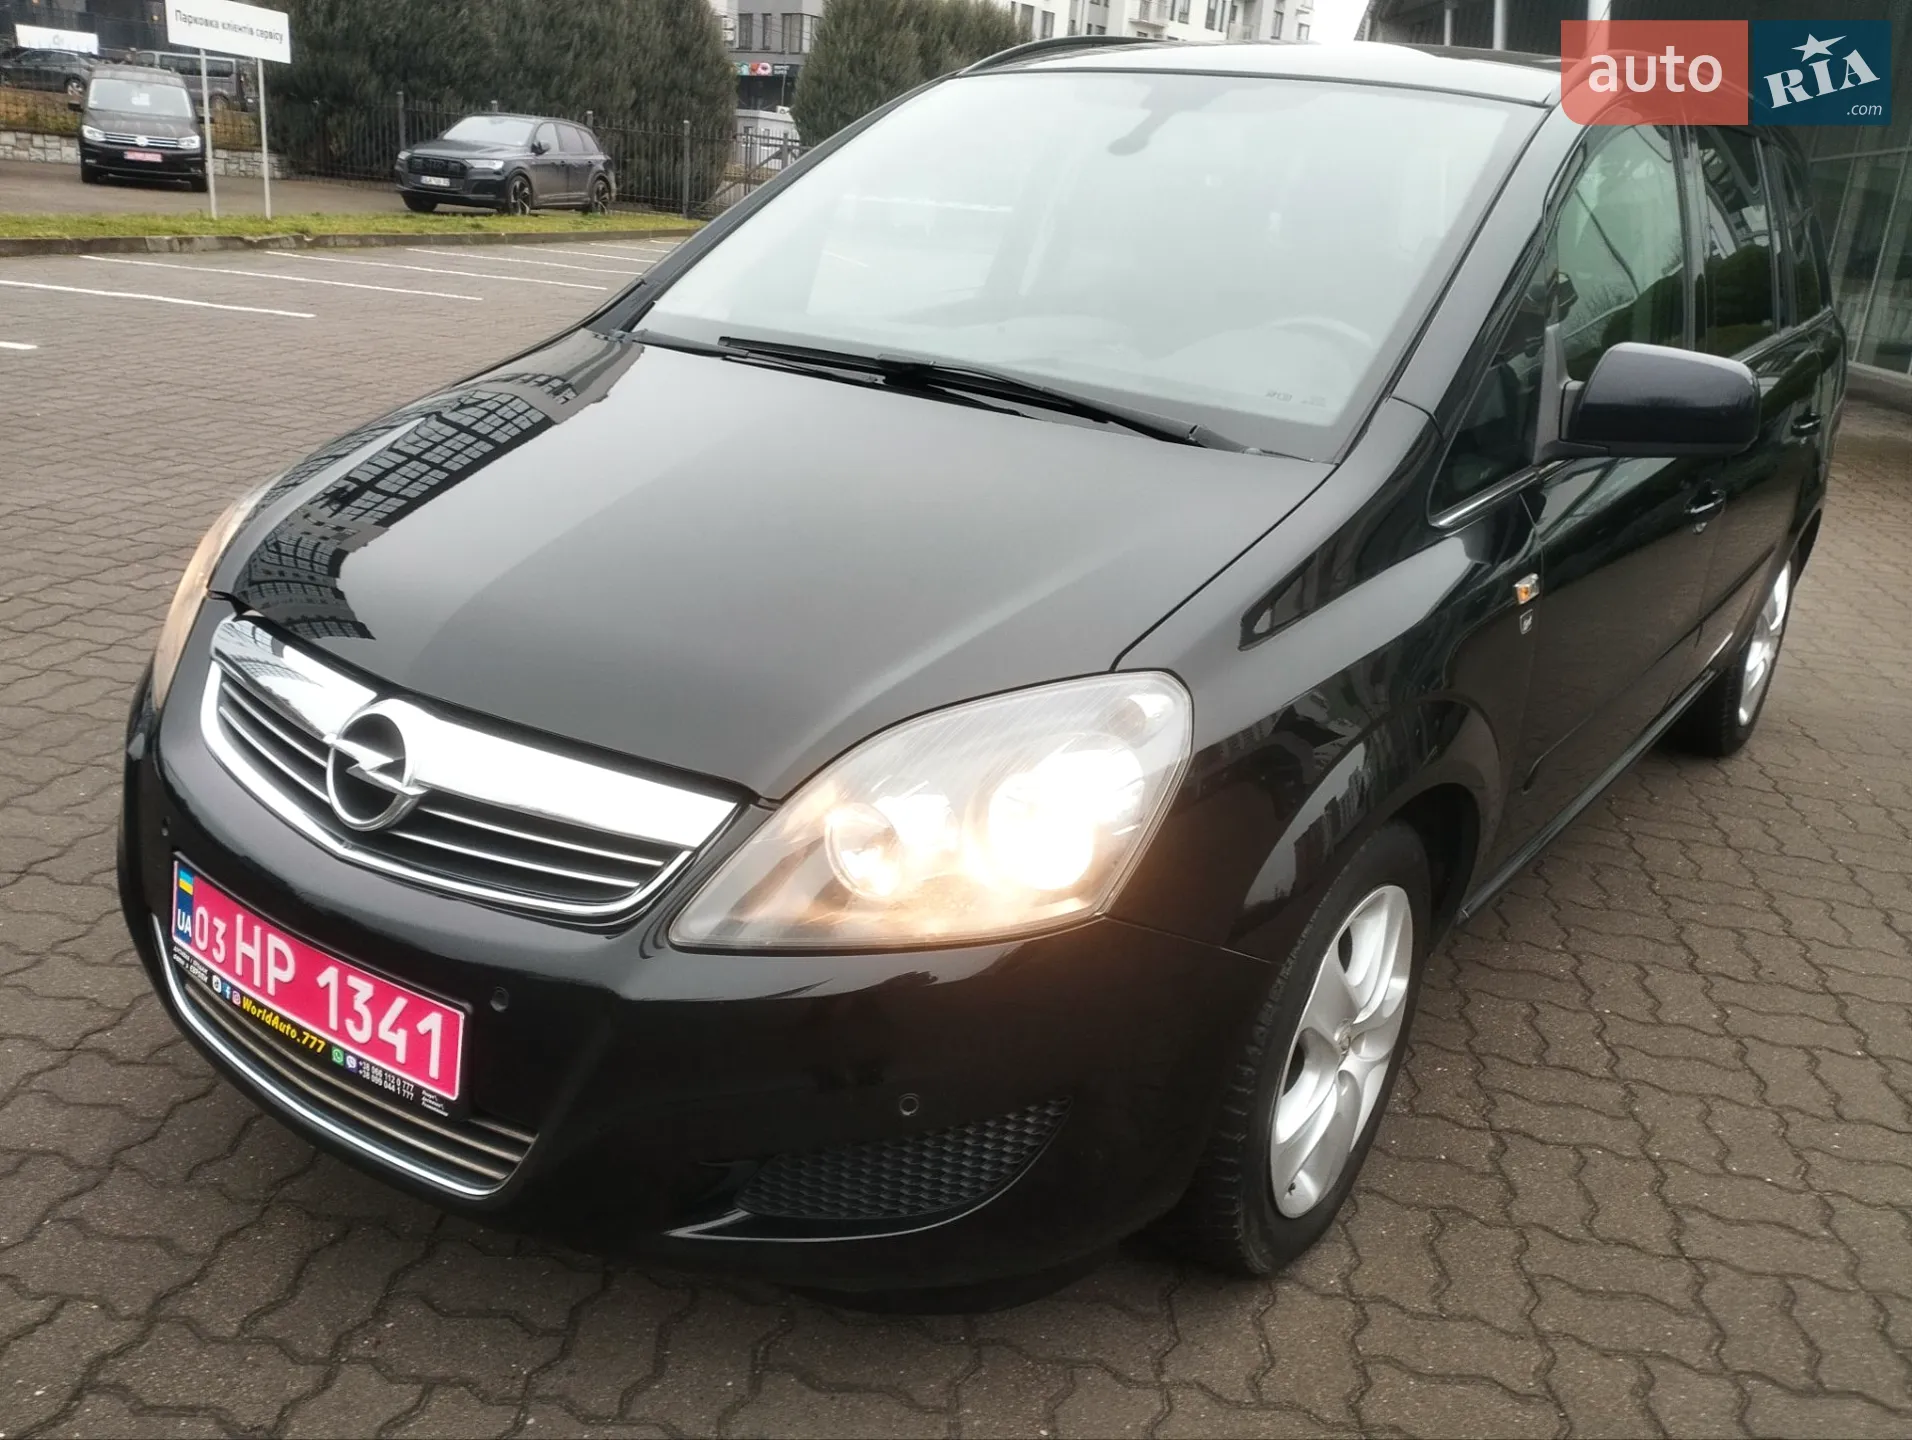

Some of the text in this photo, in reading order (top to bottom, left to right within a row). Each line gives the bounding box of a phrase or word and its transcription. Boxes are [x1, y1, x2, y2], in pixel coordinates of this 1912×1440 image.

[175, 9, 284, 44] Парковка клієнтів сервісу
[176, 908, 193, 938] UA
[194, 906, 444, 1080] 03 HP 1341
[242, 996, 327, 1054] WorldAuto.777
